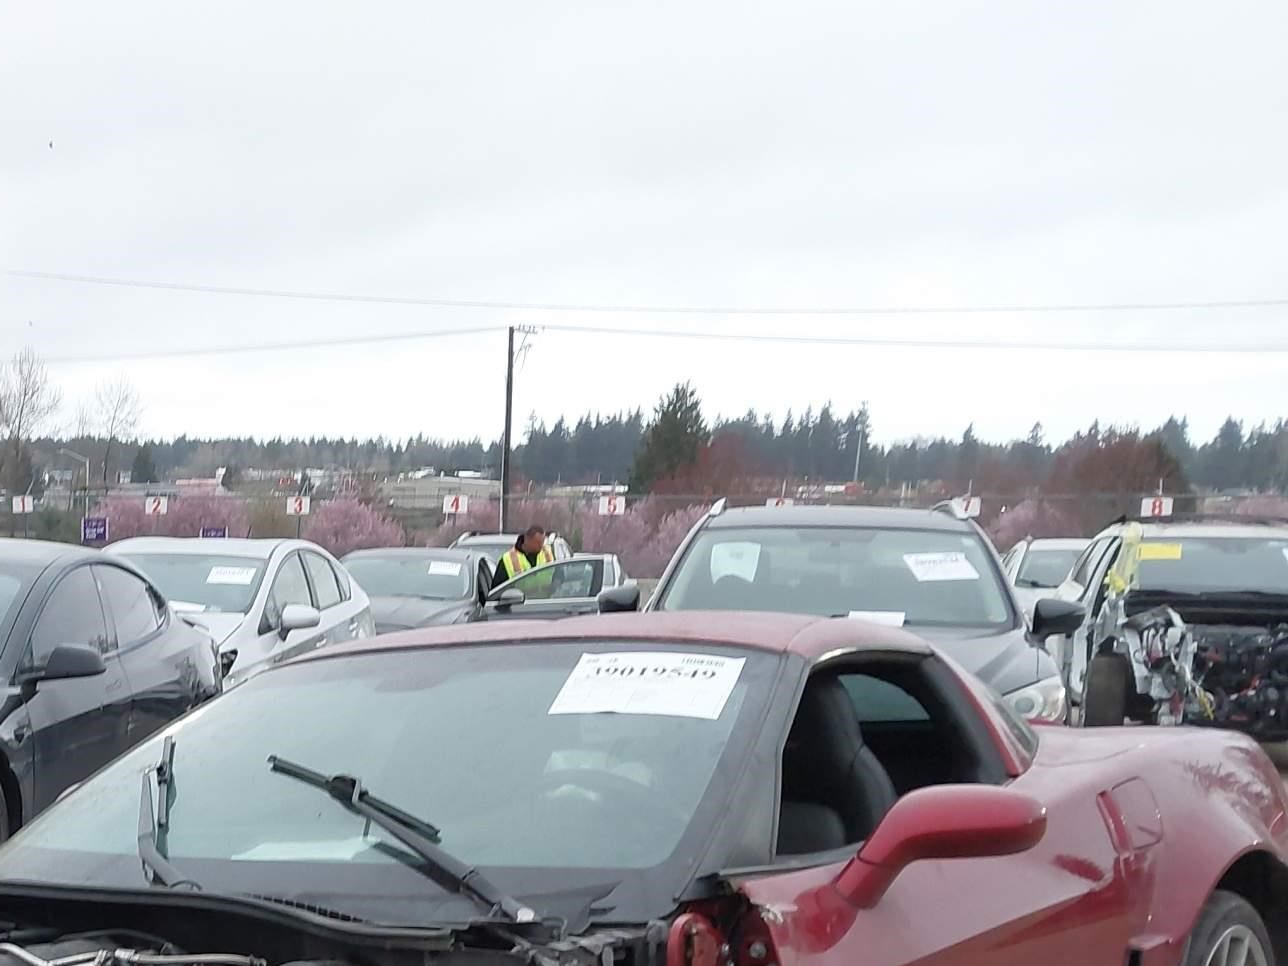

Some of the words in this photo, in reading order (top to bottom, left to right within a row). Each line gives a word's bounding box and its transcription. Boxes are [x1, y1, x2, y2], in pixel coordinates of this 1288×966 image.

[152, 496, 161, 513] 2
[294, 496, 303, 513] 3
[450, 496, 460, 513] 4
[607, 496, 617, 513] 5
[962, 497, 972, 513] 7
[1151, 497, 1163, 517] 8
